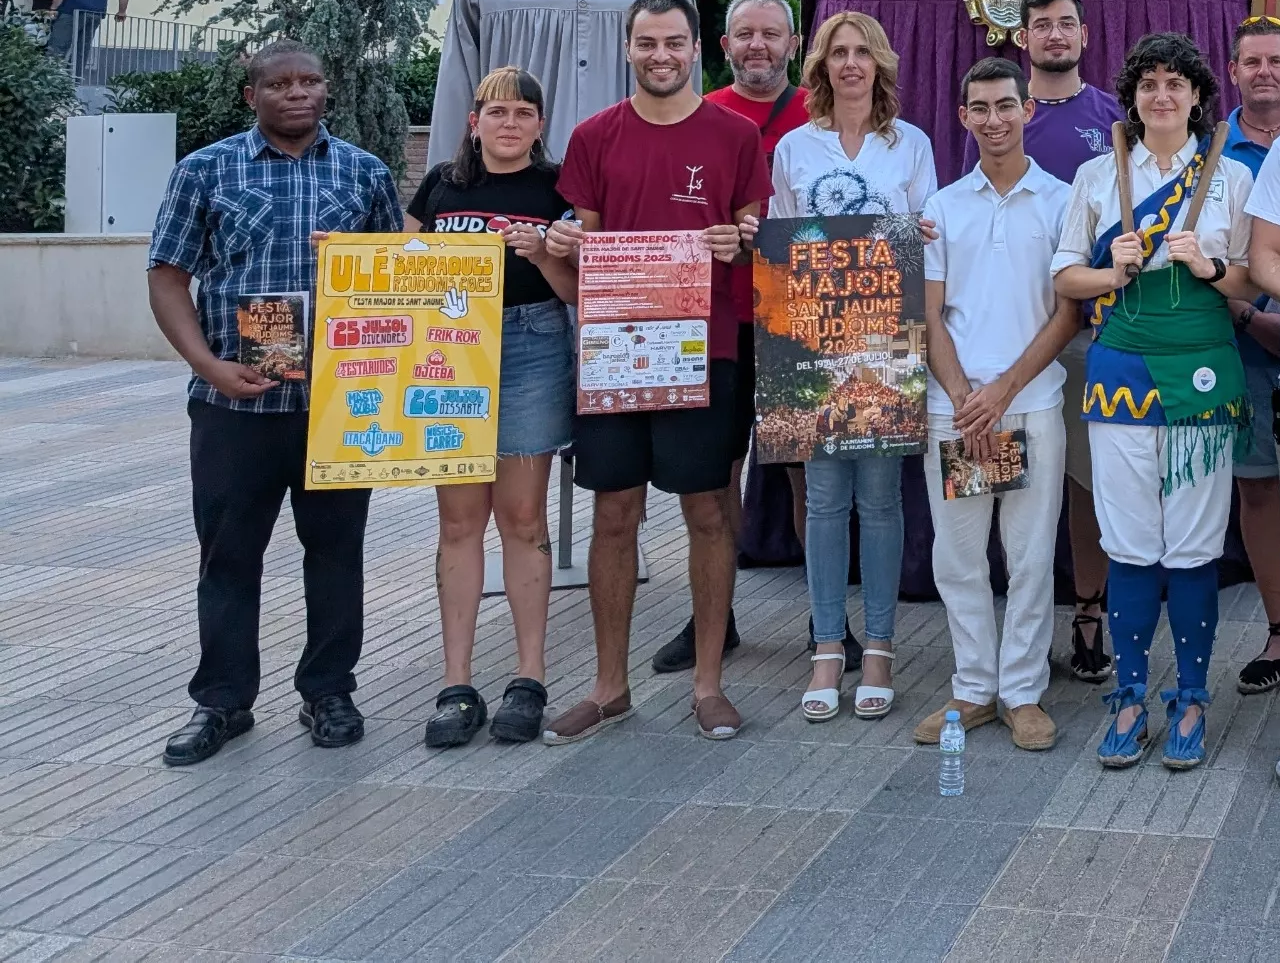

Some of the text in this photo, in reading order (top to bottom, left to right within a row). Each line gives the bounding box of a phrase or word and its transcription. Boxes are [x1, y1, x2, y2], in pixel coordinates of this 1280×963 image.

[619, 235, 678, 244] CORREFOC
[592, 254, 672, 263] RIUDOMS 2025
[789, 238, 895, 271] FESTA
[331, 247, 494, 292] ULÉ BARRAQUES
[393, 275, 493, 292] RIUDOMS 2025
[786, 267, 903, 300] MAJOR
[250, 301, 291, 313] FESTA
[787, 297, 903, 318] SANT JAUME
[248, 313, 294, 324] MAJOR
[333, 319, 407, 346] 25 JULIOL
[428, 328, 479, 343] FRIK ROK
[790, 315, 900, 341] RIUDOMS
[361, 333, 406, 345] DIVENDRES
[822, 338, 868, 354] 2025
[340, 359, 396, 377] TESTARUDES
[796, 361, 812, 371] DEL
[864, 351, 894, 362] JULIOL
[415, 366, 454, 380] DJ CEBA
[410, 390, 484, 414] 26 JULIOL
[440, 403, 482, 415] DISSABTE
[376, 431, 402, 445] BAND
[999, 442, 1011, 483] MAJOR
[1009, 441, 1022, 479] FESTA
